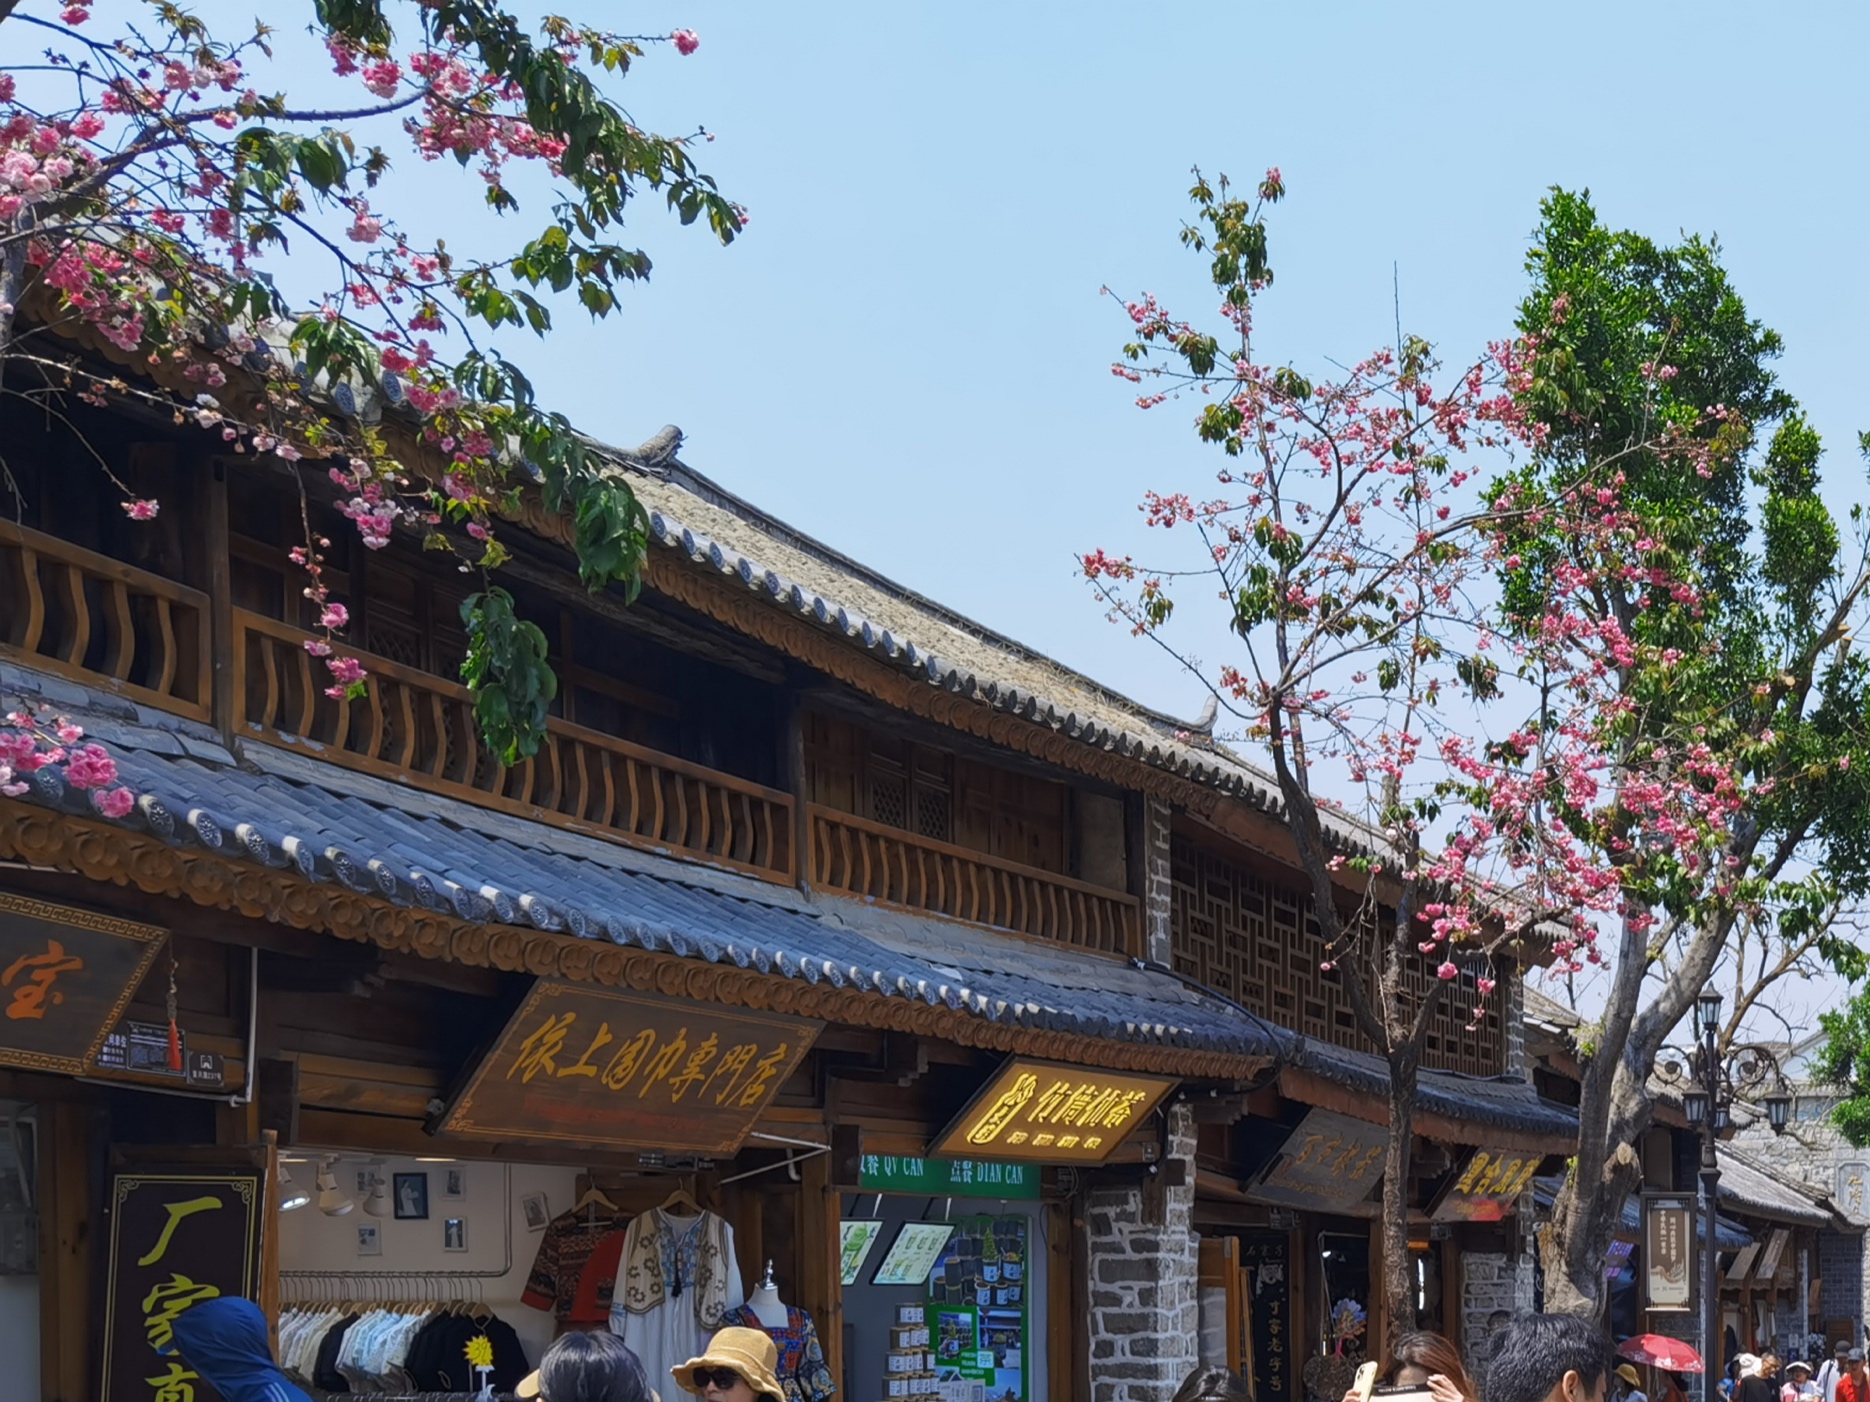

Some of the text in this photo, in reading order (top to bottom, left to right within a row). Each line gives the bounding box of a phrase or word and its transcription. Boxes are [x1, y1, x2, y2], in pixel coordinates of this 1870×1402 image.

[902, 1158, 925, 1177] CAN
[976, 1161, 1002, 1184] DIAN
[1004, 1164, 1024, 1185] CAN
